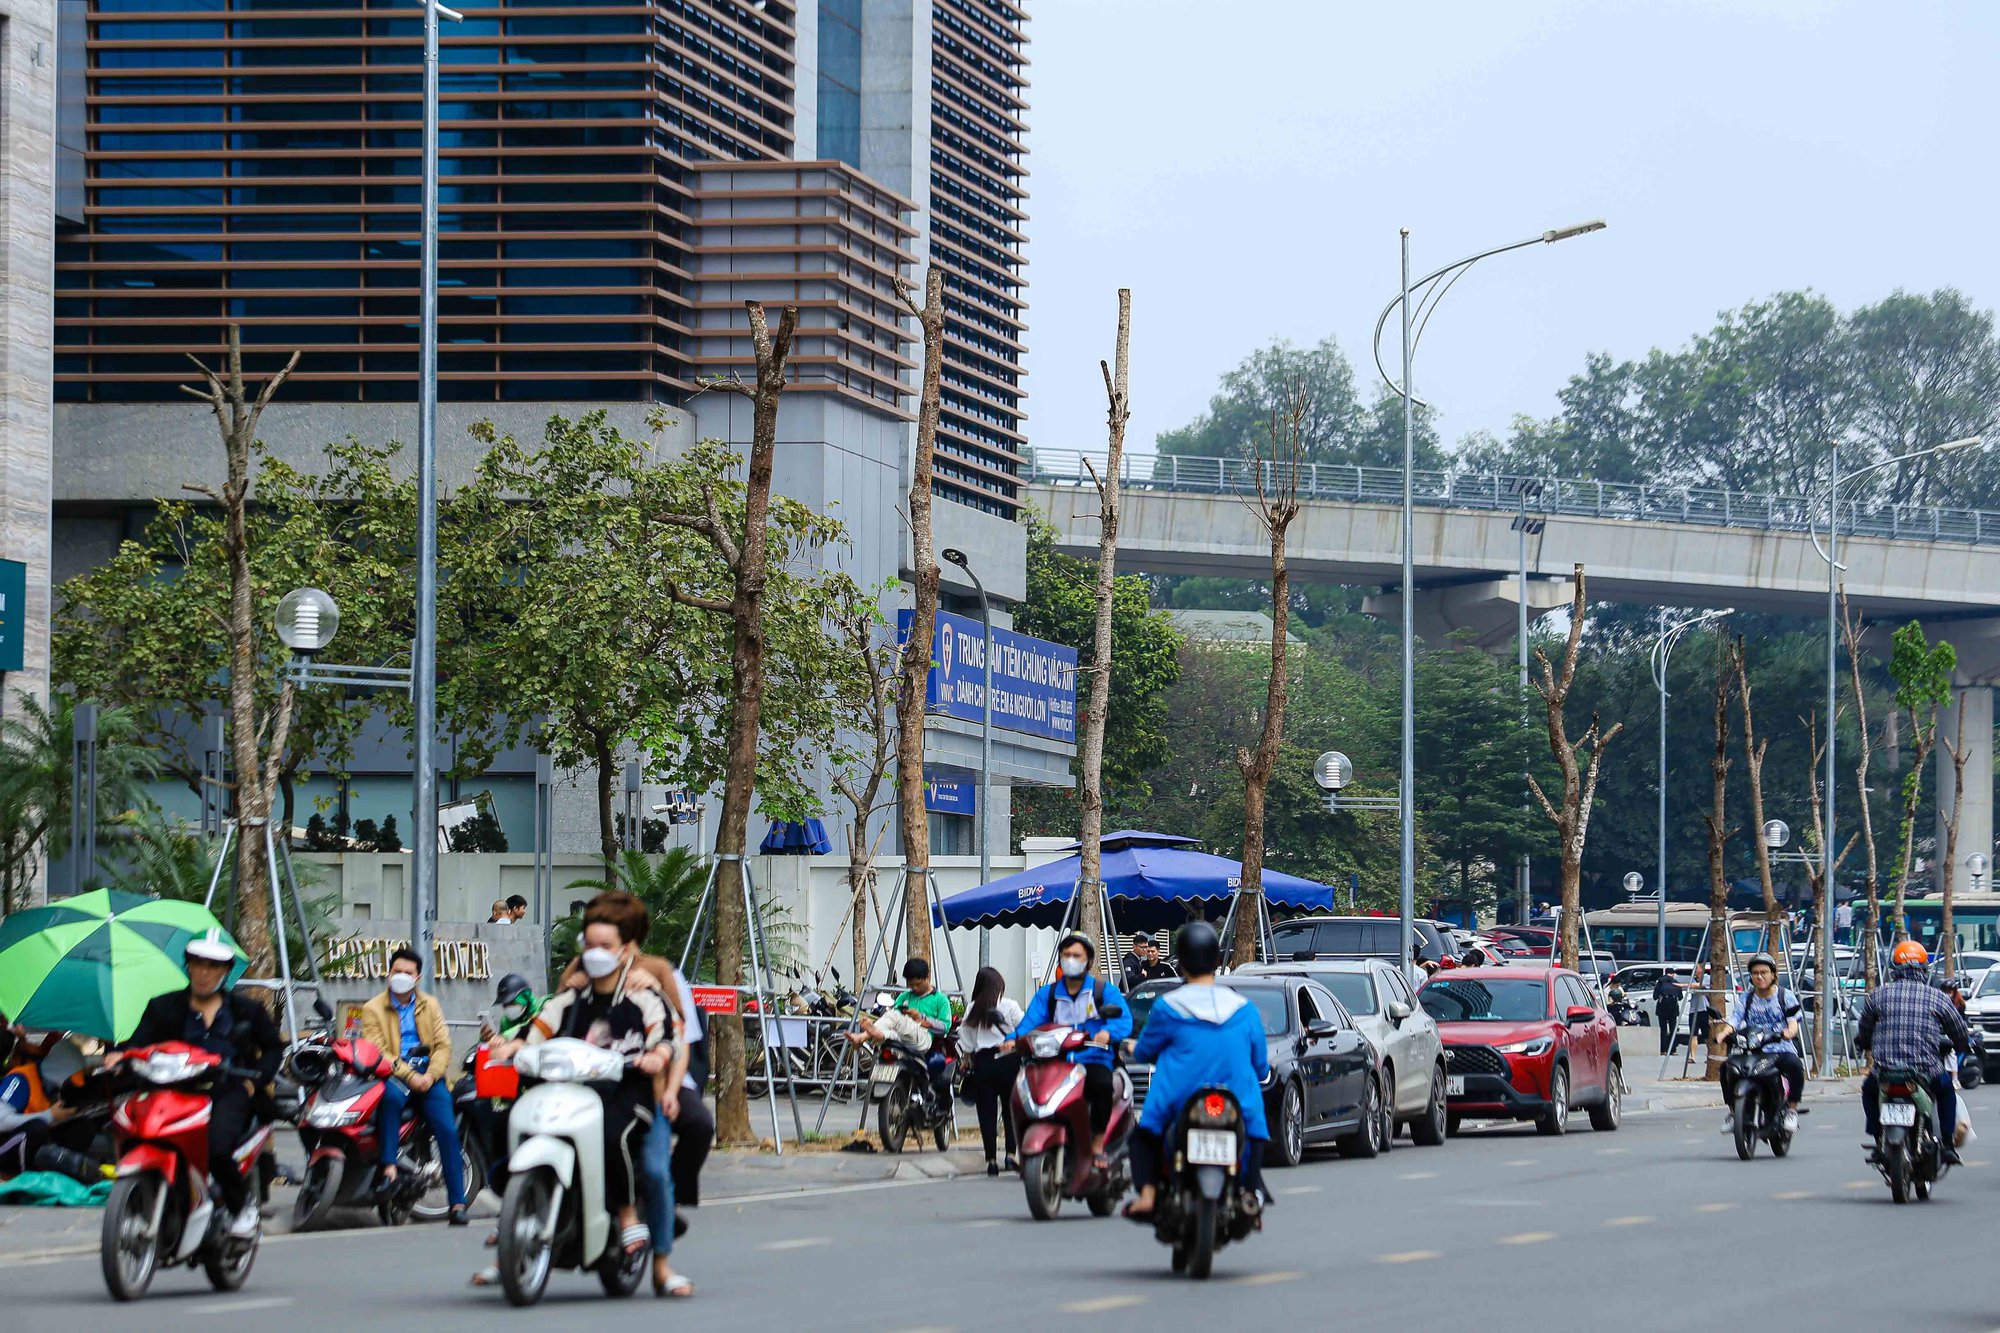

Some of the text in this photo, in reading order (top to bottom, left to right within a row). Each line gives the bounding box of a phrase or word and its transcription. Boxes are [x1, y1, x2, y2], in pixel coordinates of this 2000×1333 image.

[957, 632, 985, 669] TRUNG
[990, 635, 1002, 674] ÂM
[1003, 640, 1021, 679] TIÊM
[1021, 646, 1047, 686] CHỦNG
[1061, 661, 1075, 692] XIN
[957, 674, 974, 706] DÀNH
[974, 683, 985, 708] CH
[991, 683, 1000, 712] RẺ
[1000, 690, 1009, 714] EM
[1009, 693, 1014, 714] &
[1014, 691, 1034, 720] NGƯỜI
[1034, 695, 1046, 722] LỚN
[1018, 885, 1037, 899] BIDV
[435, 940, 494, 979] TOWER
